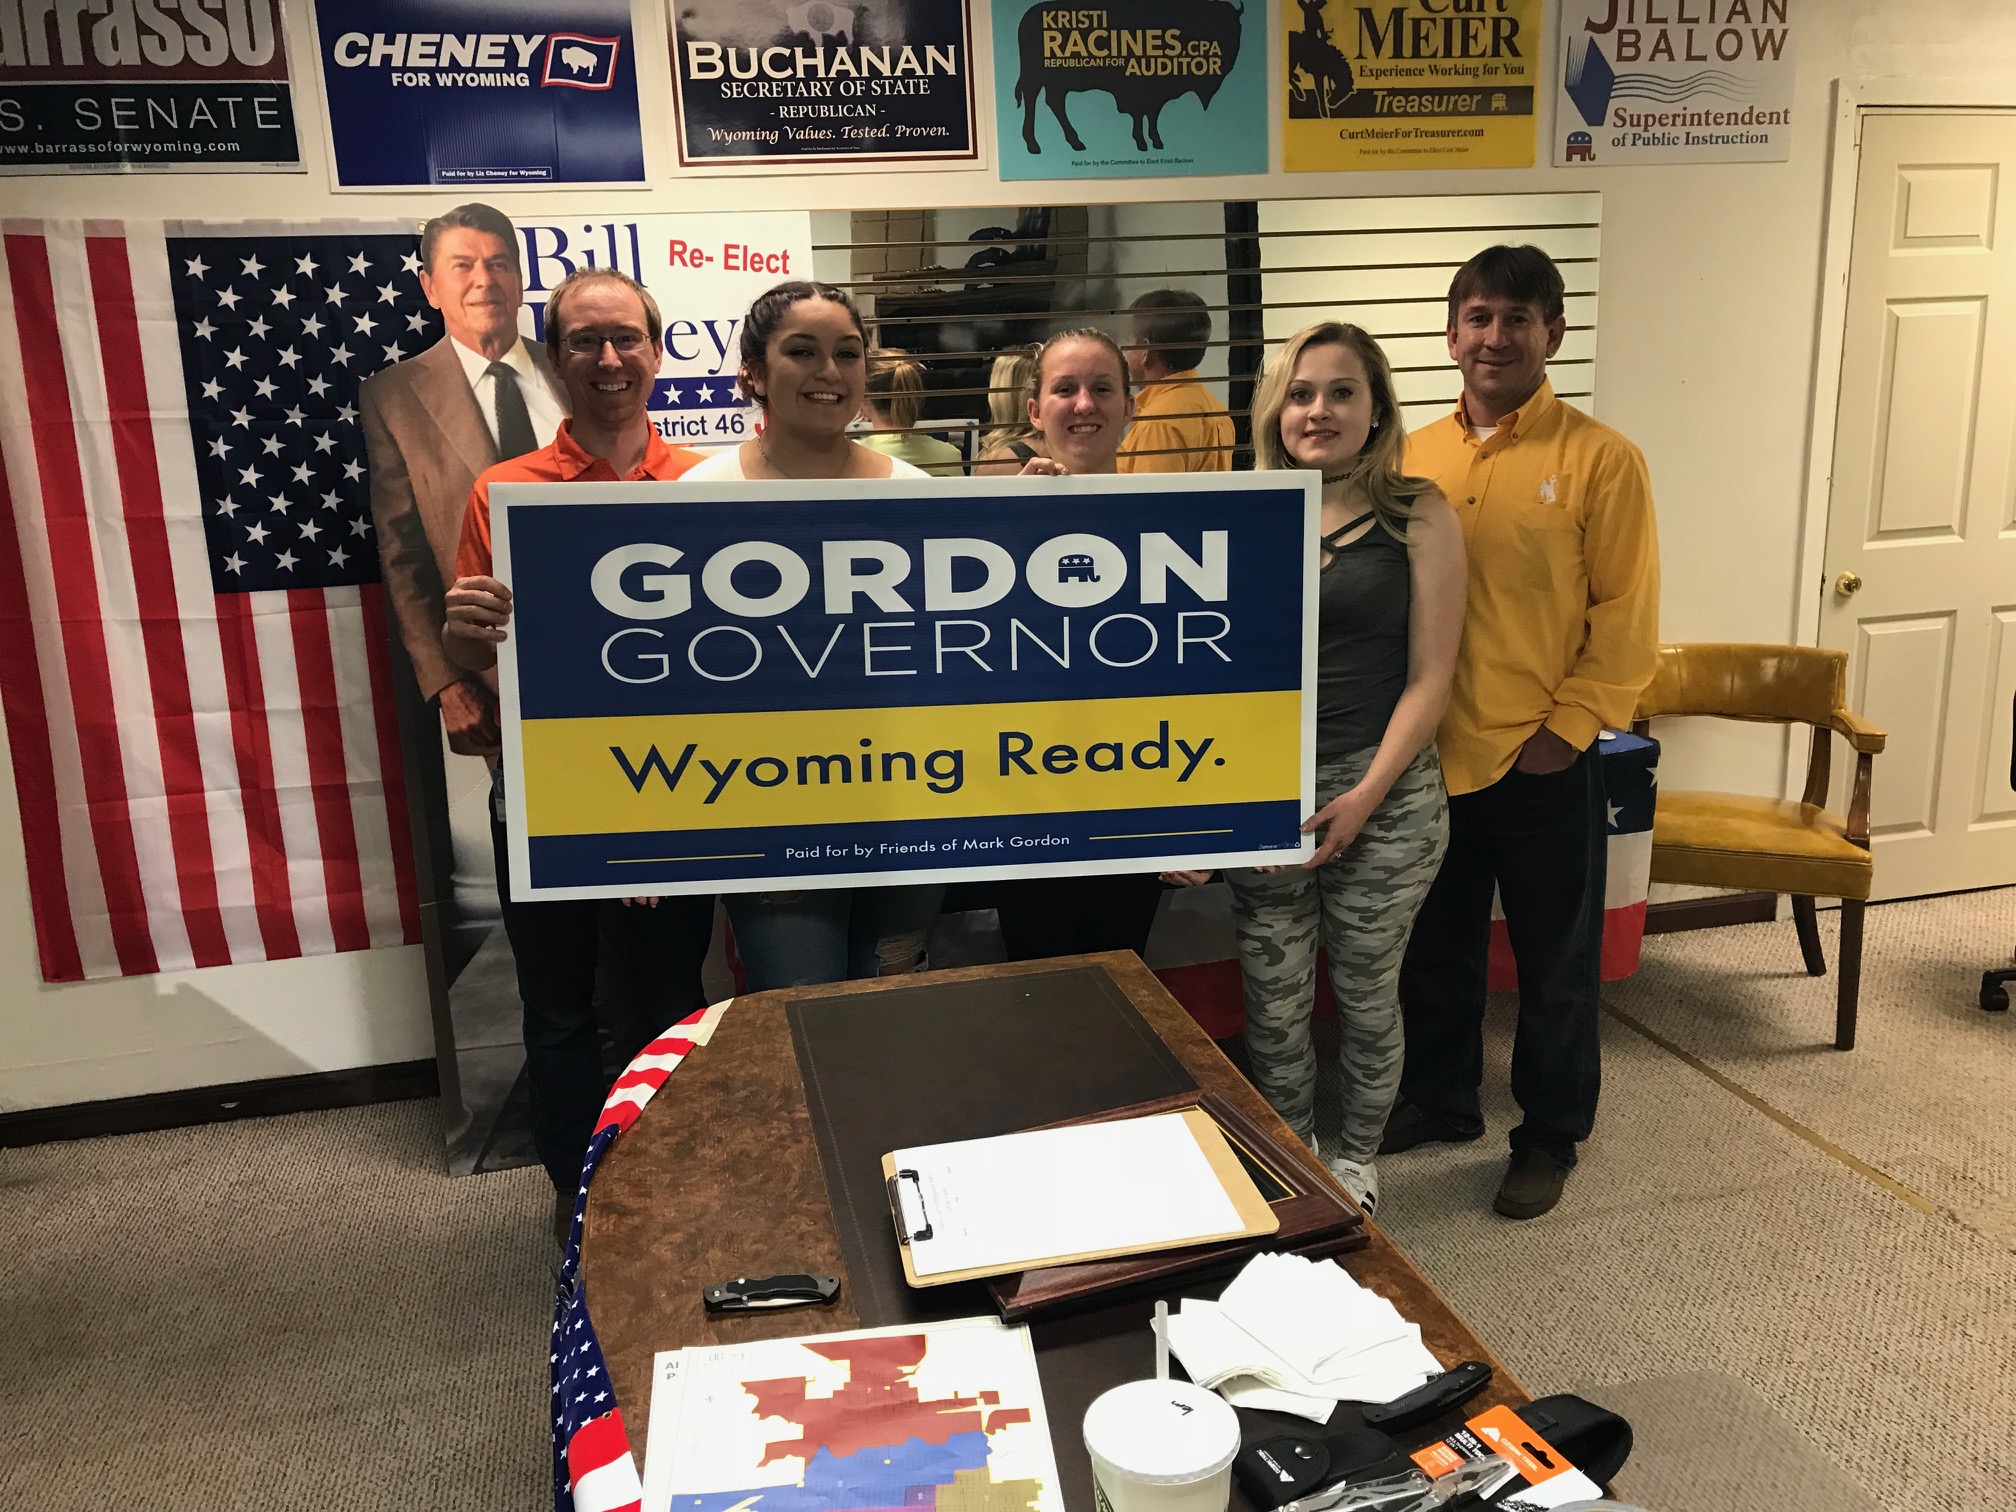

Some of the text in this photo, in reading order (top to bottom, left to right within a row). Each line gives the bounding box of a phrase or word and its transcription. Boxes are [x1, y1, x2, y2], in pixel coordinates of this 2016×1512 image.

[1042, 10, 1108, 28] KRISTI
[1584, 0, 1788, 34] JILLIAN
[1354, 7, 1523, 60] MEIER
[1615, 28, 1790, 62] BALOW
[334, 32, 547, 68] CHENEY
[1044, 57, 1222, 76] REPUBLICAN FOR AUDITOR
[1359, 63, 1525, 80] Experience Working for You
[391, 72, 530, 87] FOR WYOMING
[720, 78, 931, 98] SECRETARY OF STATE
[778, 104, 876, 119] REPUBLICAN
[1373, 90, 1482, 113] Treasurer
[74, 97, 282, 131] SENATE
[1613, 106, 1791, 132] Superintendent
[706, 124, 950, 146] Wyoming Values. Tested. Proven.
[1339, 128, 1484, 140] CurtMeierForTreasurer.com
[1612, 130, 1769, 147] of Public Instruction
[0, 140, 241, 155] ww.barrassoforwyoming.com
[515, 223, 649, 291] Bill
[669, 239, 790, 275] Re- Elect
[714, 413, 746, 435] 46
[590, 529, 1229, 621] GORDON
[600, 611, 1233, 685] GOVERNOR
[609, 720, 1227, 805] Wyoming Ready.
[785, 834, 1070, 859] Paid for by Friends of Mark Gordon
